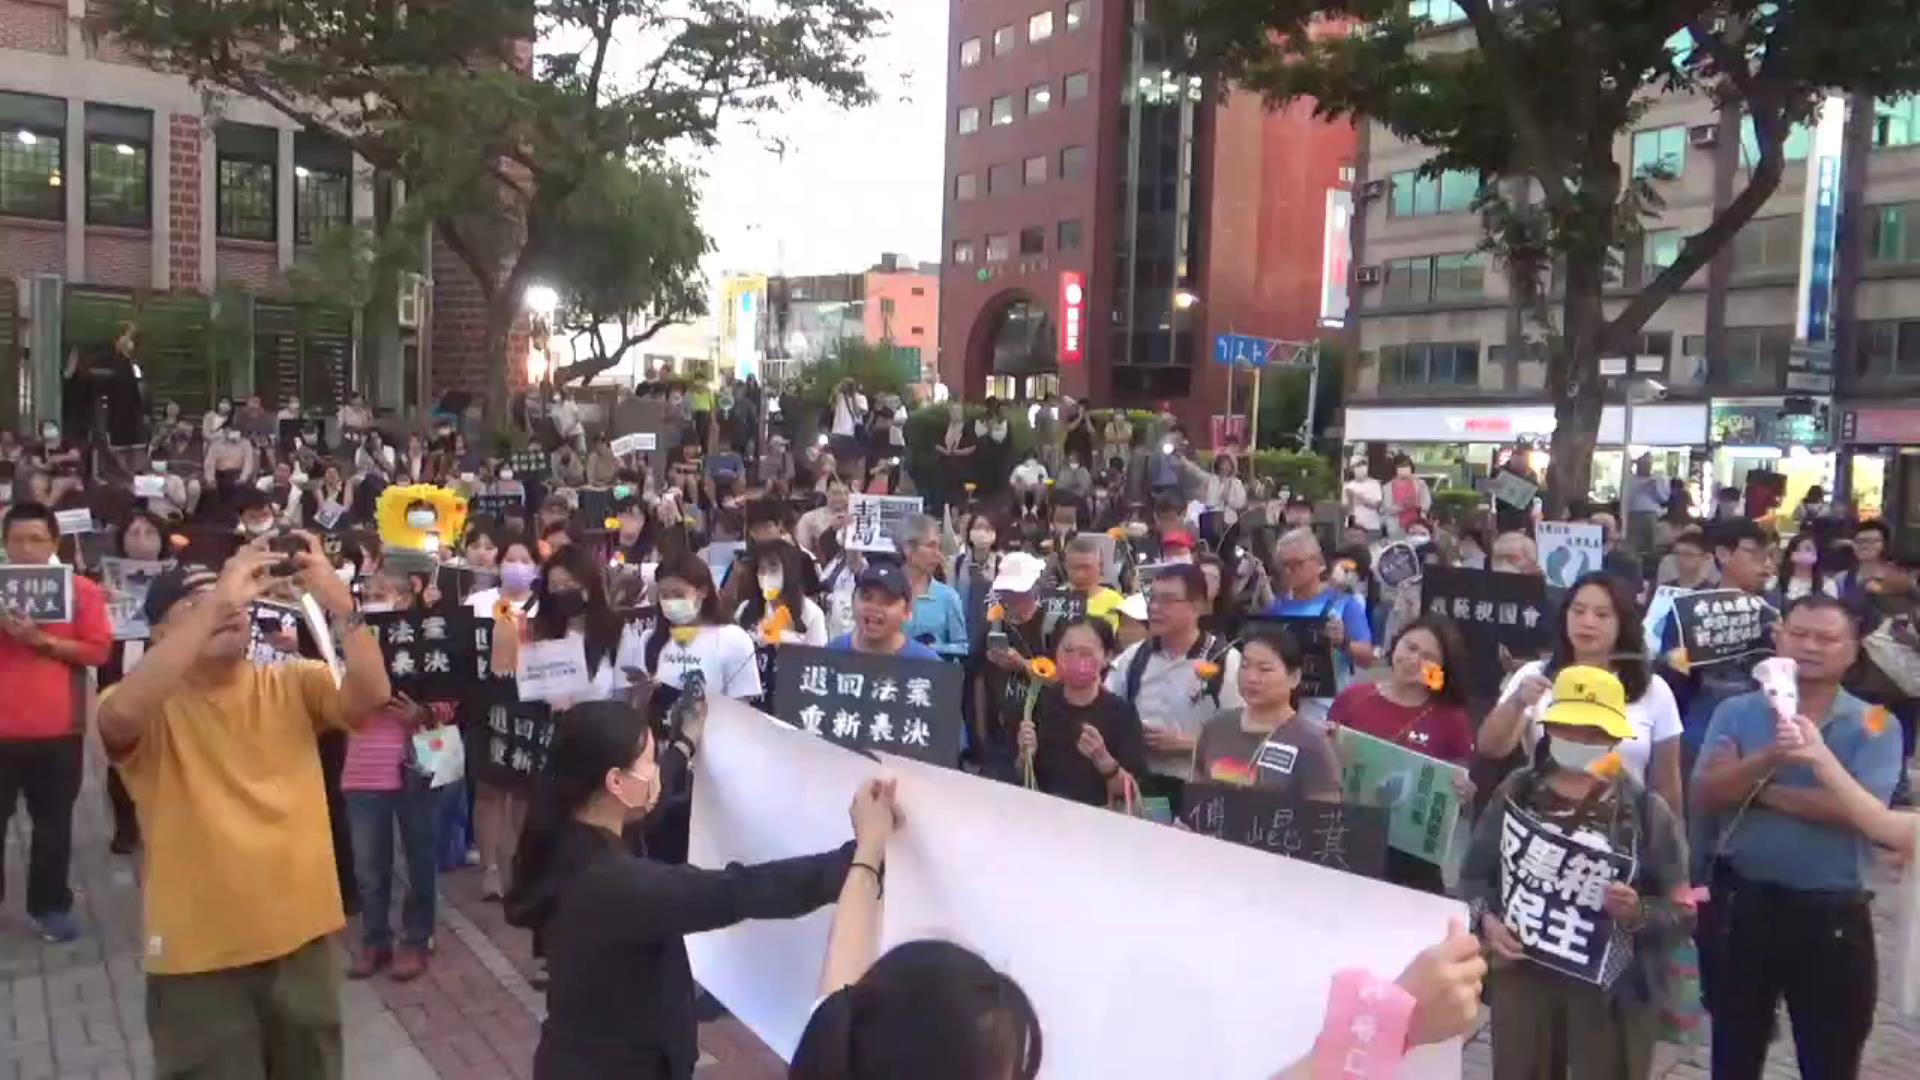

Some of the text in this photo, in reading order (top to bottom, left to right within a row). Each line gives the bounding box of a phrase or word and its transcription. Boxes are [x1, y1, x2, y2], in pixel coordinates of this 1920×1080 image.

[799, 664, 932, 708] 退回法案
[798, 703, 931, 746] 重新表決
